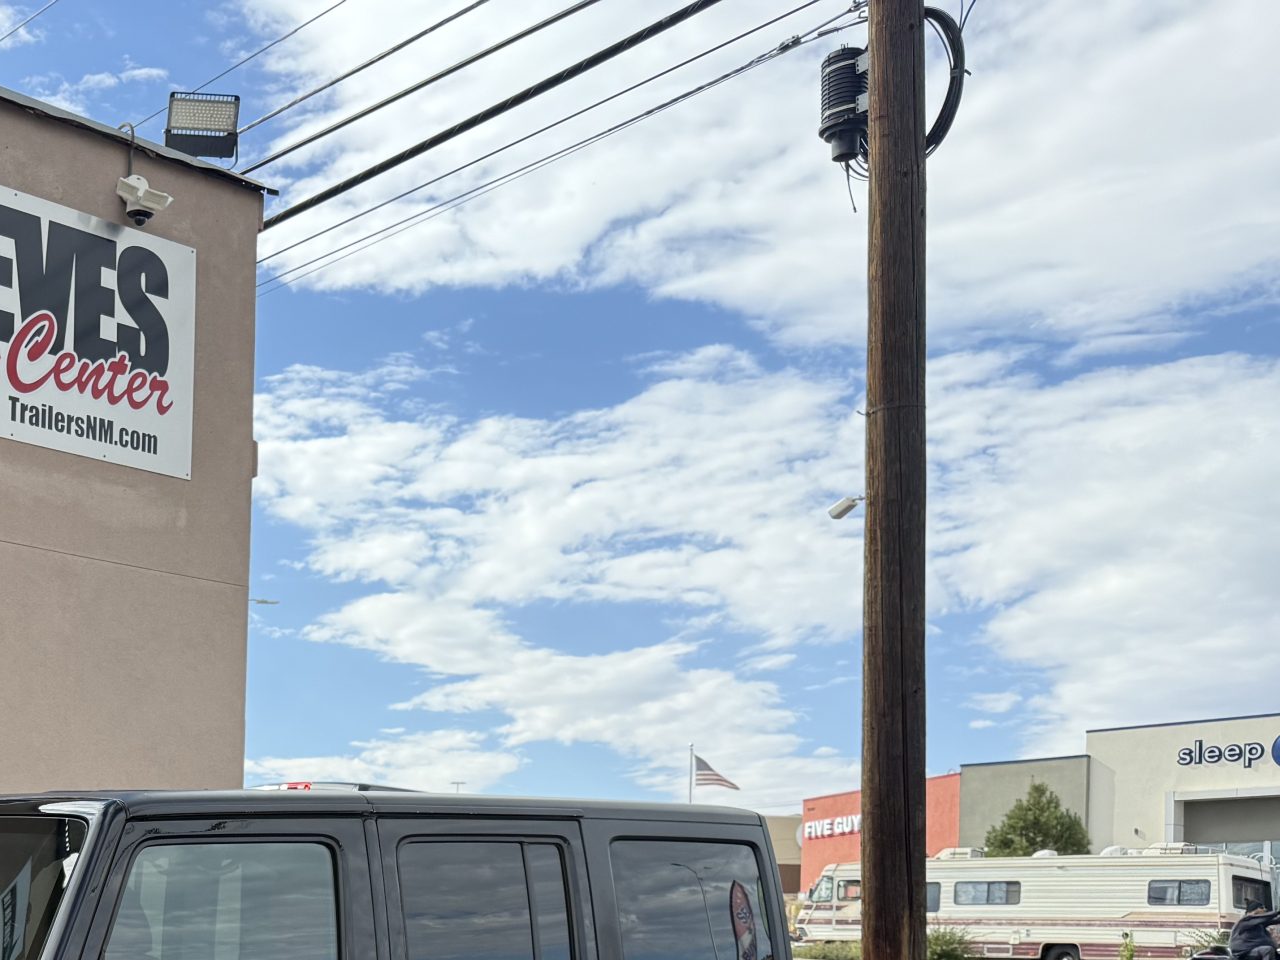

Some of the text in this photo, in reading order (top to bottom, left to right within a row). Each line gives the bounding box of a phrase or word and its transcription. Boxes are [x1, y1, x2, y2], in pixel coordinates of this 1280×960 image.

[6, 310, 173, 415] Center
[7, 395, 158, 456] TrailersNM.com
[1177, 740, 1265, 768] sleep
[804, 814, 861, 839] FIVE GUY
